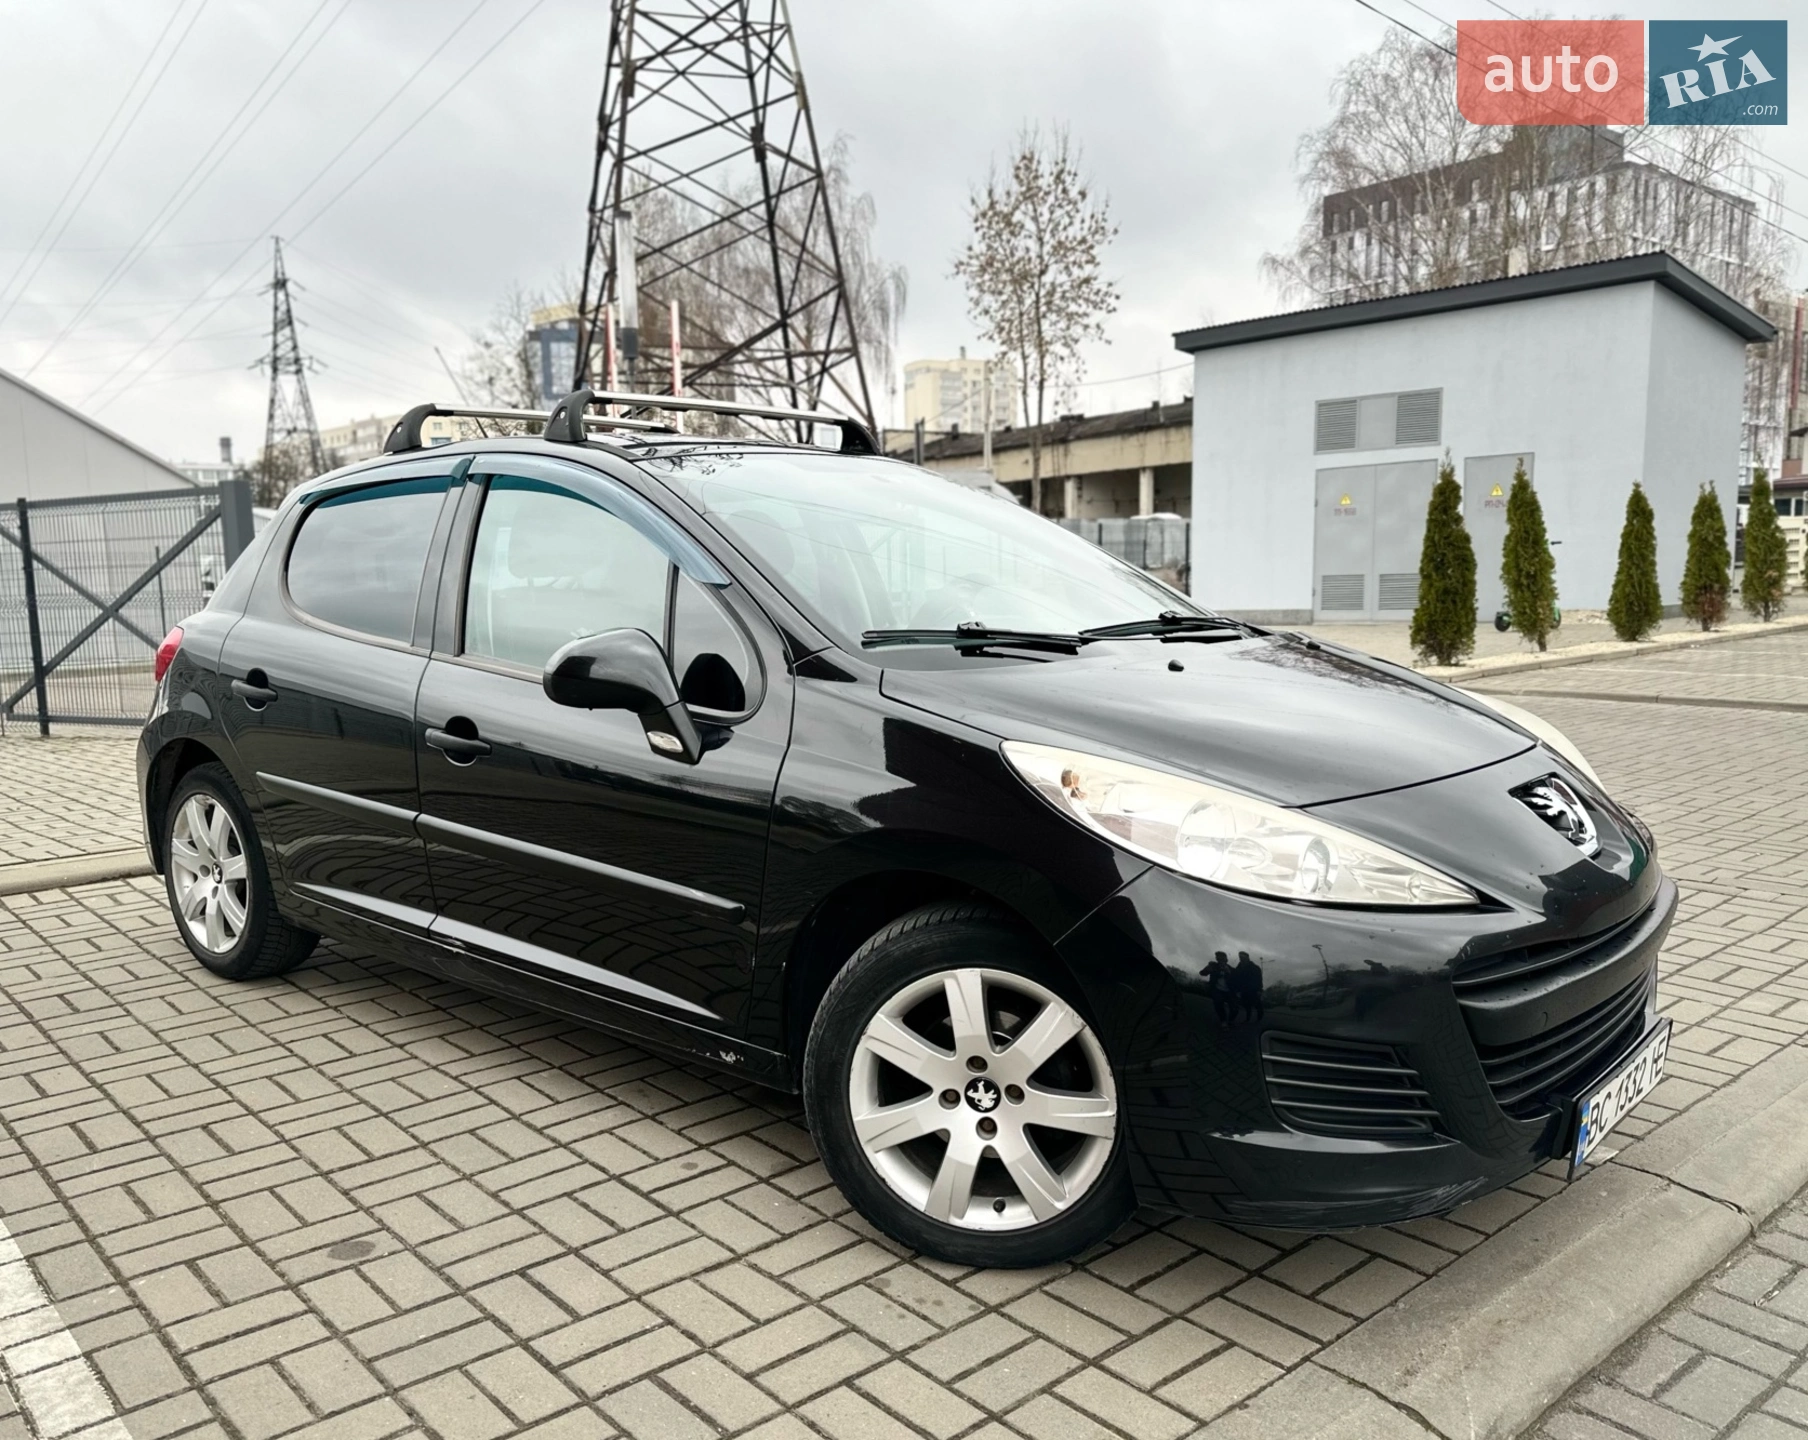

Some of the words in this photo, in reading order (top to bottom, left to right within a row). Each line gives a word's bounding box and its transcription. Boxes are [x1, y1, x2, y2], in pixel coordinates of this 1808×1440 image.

[1588, 1092, 1611, 1147] BC
[1614, 1057, 1647, 1117] 1332
[1650, 1036, 1666, 1085] HE
